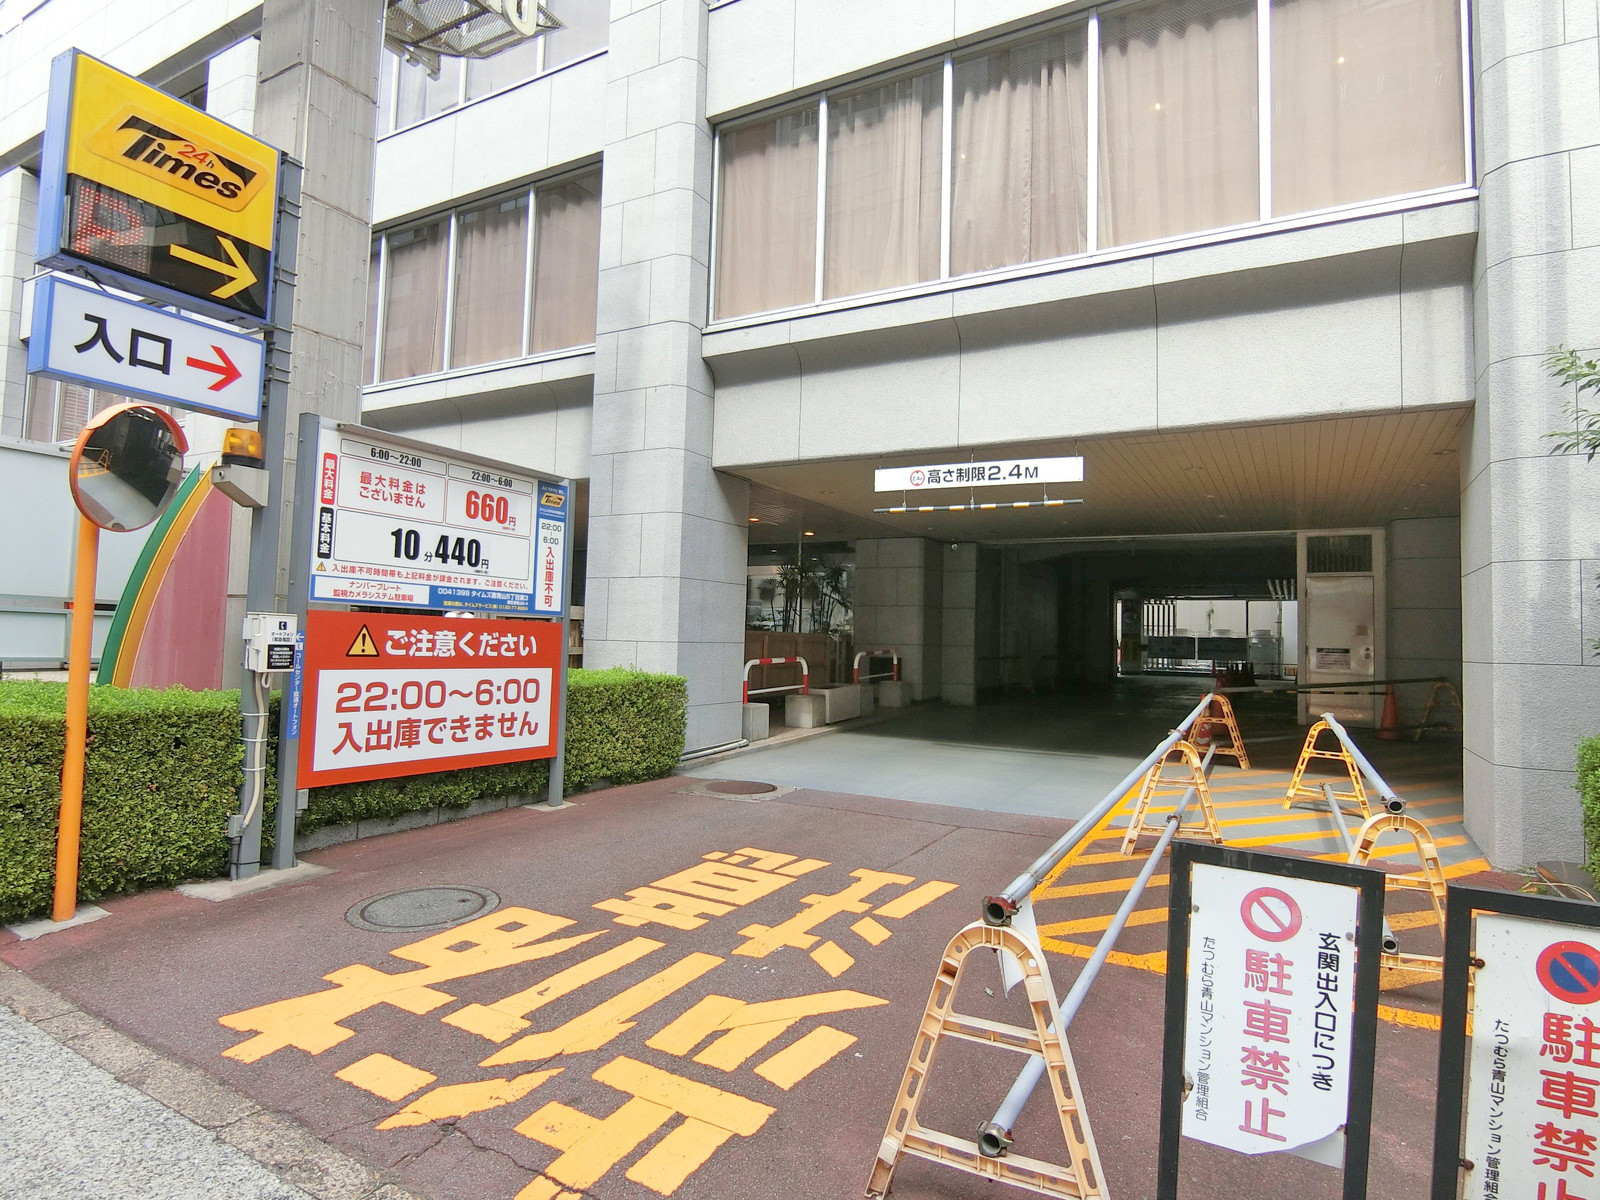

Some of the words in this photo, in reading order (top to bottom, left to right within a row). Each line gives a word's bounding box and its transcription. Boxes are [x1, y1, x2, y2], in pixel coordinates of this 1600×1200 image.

[116, 115, 257, 201] Times
[177, 143, 215, 169] 24h
[75, 185, 145, 257] P
[73, 312, 173, 375] 入口
[323, 458, 335, 499] 最大料金
[360, 471, 426, 495] 最大料金は
[927, 464, 1039, 485] 高さ制限2.4M
[359, 486, 426, 508] ございません
[320, 512, 333, 555] 基本料金
[541, 522, 562, 532] 22:00
[543, 536, 559, 545] 6:00
[349, 580, 401, 592] ナンバープレート
[544, 546, 555, 608] 入出庫不可
[333, 588, 414, 603] 監視カメラシステム駐車場
[385, 628, 537, 657] ご注意ください
[332, 711, 539, 756] 入出庫できません
[1311, 931, 1342, 1092] 玄関出入口につき
[1238, 947, 1294, 1143] 駐車禁止
